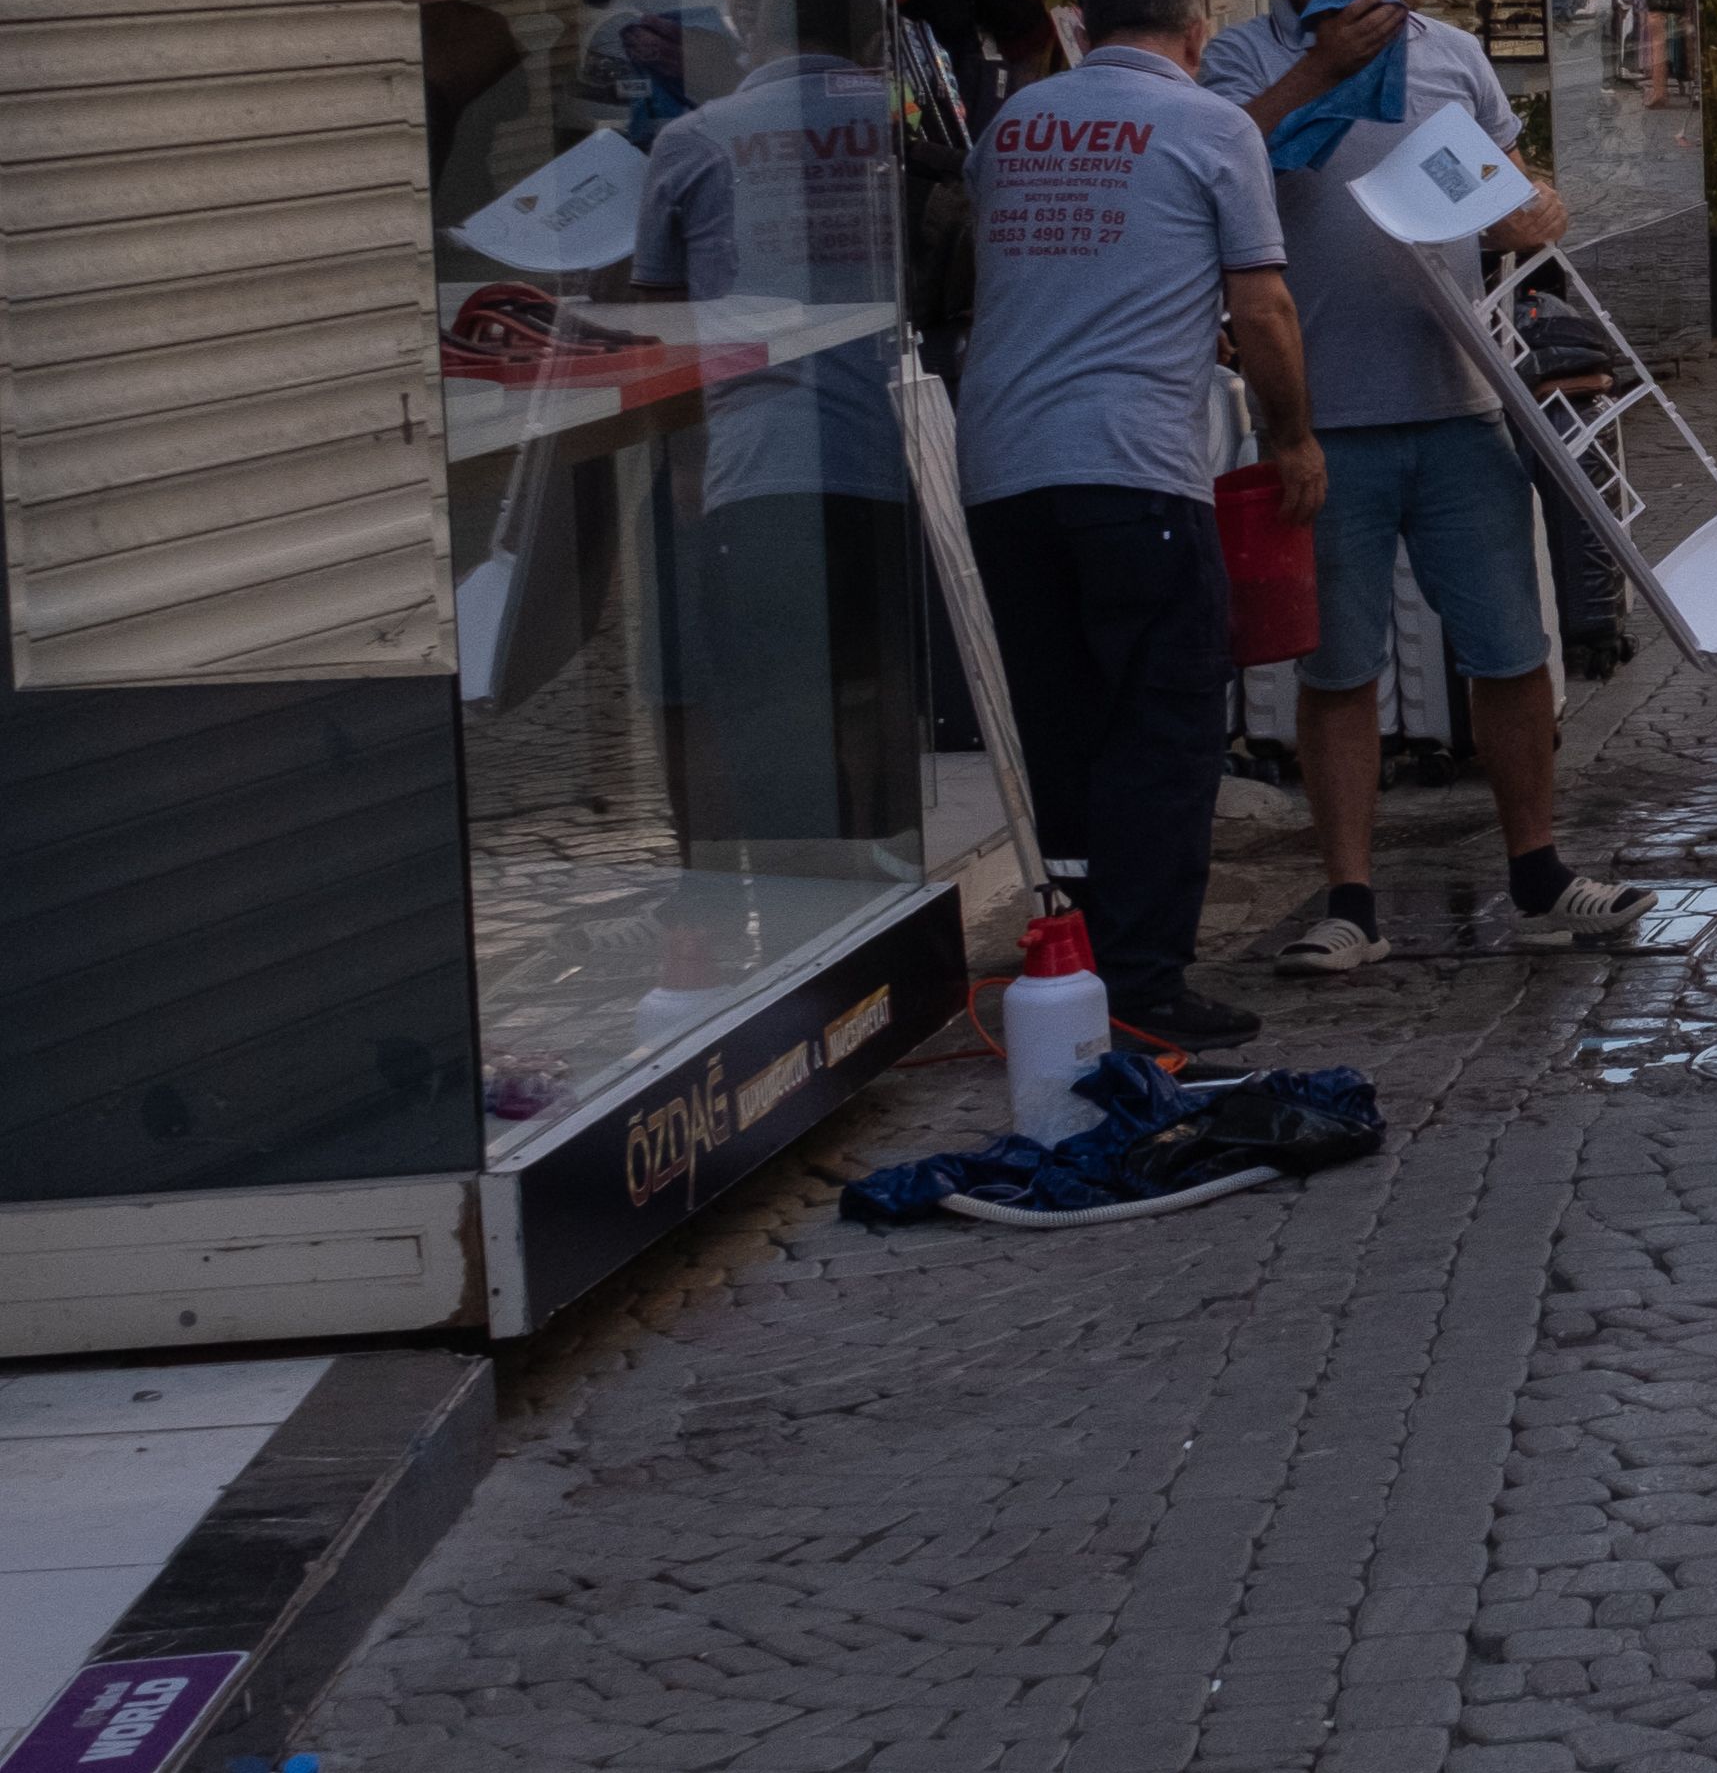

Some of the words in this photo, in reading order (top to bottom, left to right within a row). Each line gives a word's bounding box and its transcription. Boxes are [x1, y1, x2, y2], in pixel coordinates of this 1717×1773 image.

[995, 112, 1156, 155] GÜVEN
[997, 155, 1066, 173] TEKNİK
[1068, 156, 1134, 174] SERVİS
[990, 210, 1029, 224] 0544
[1034, 208, 1068, 223] 635
[1072, 208, 1095, 223] 65
[1101, 210, 1126, 225] 68
[1033, 227, 1065, 242] 490
[1099, 230, 1125, 244] 27
[626, 1052, 731, 1211] ÖZDAĞ
[78, 1676, 190, 1763] WORLD
